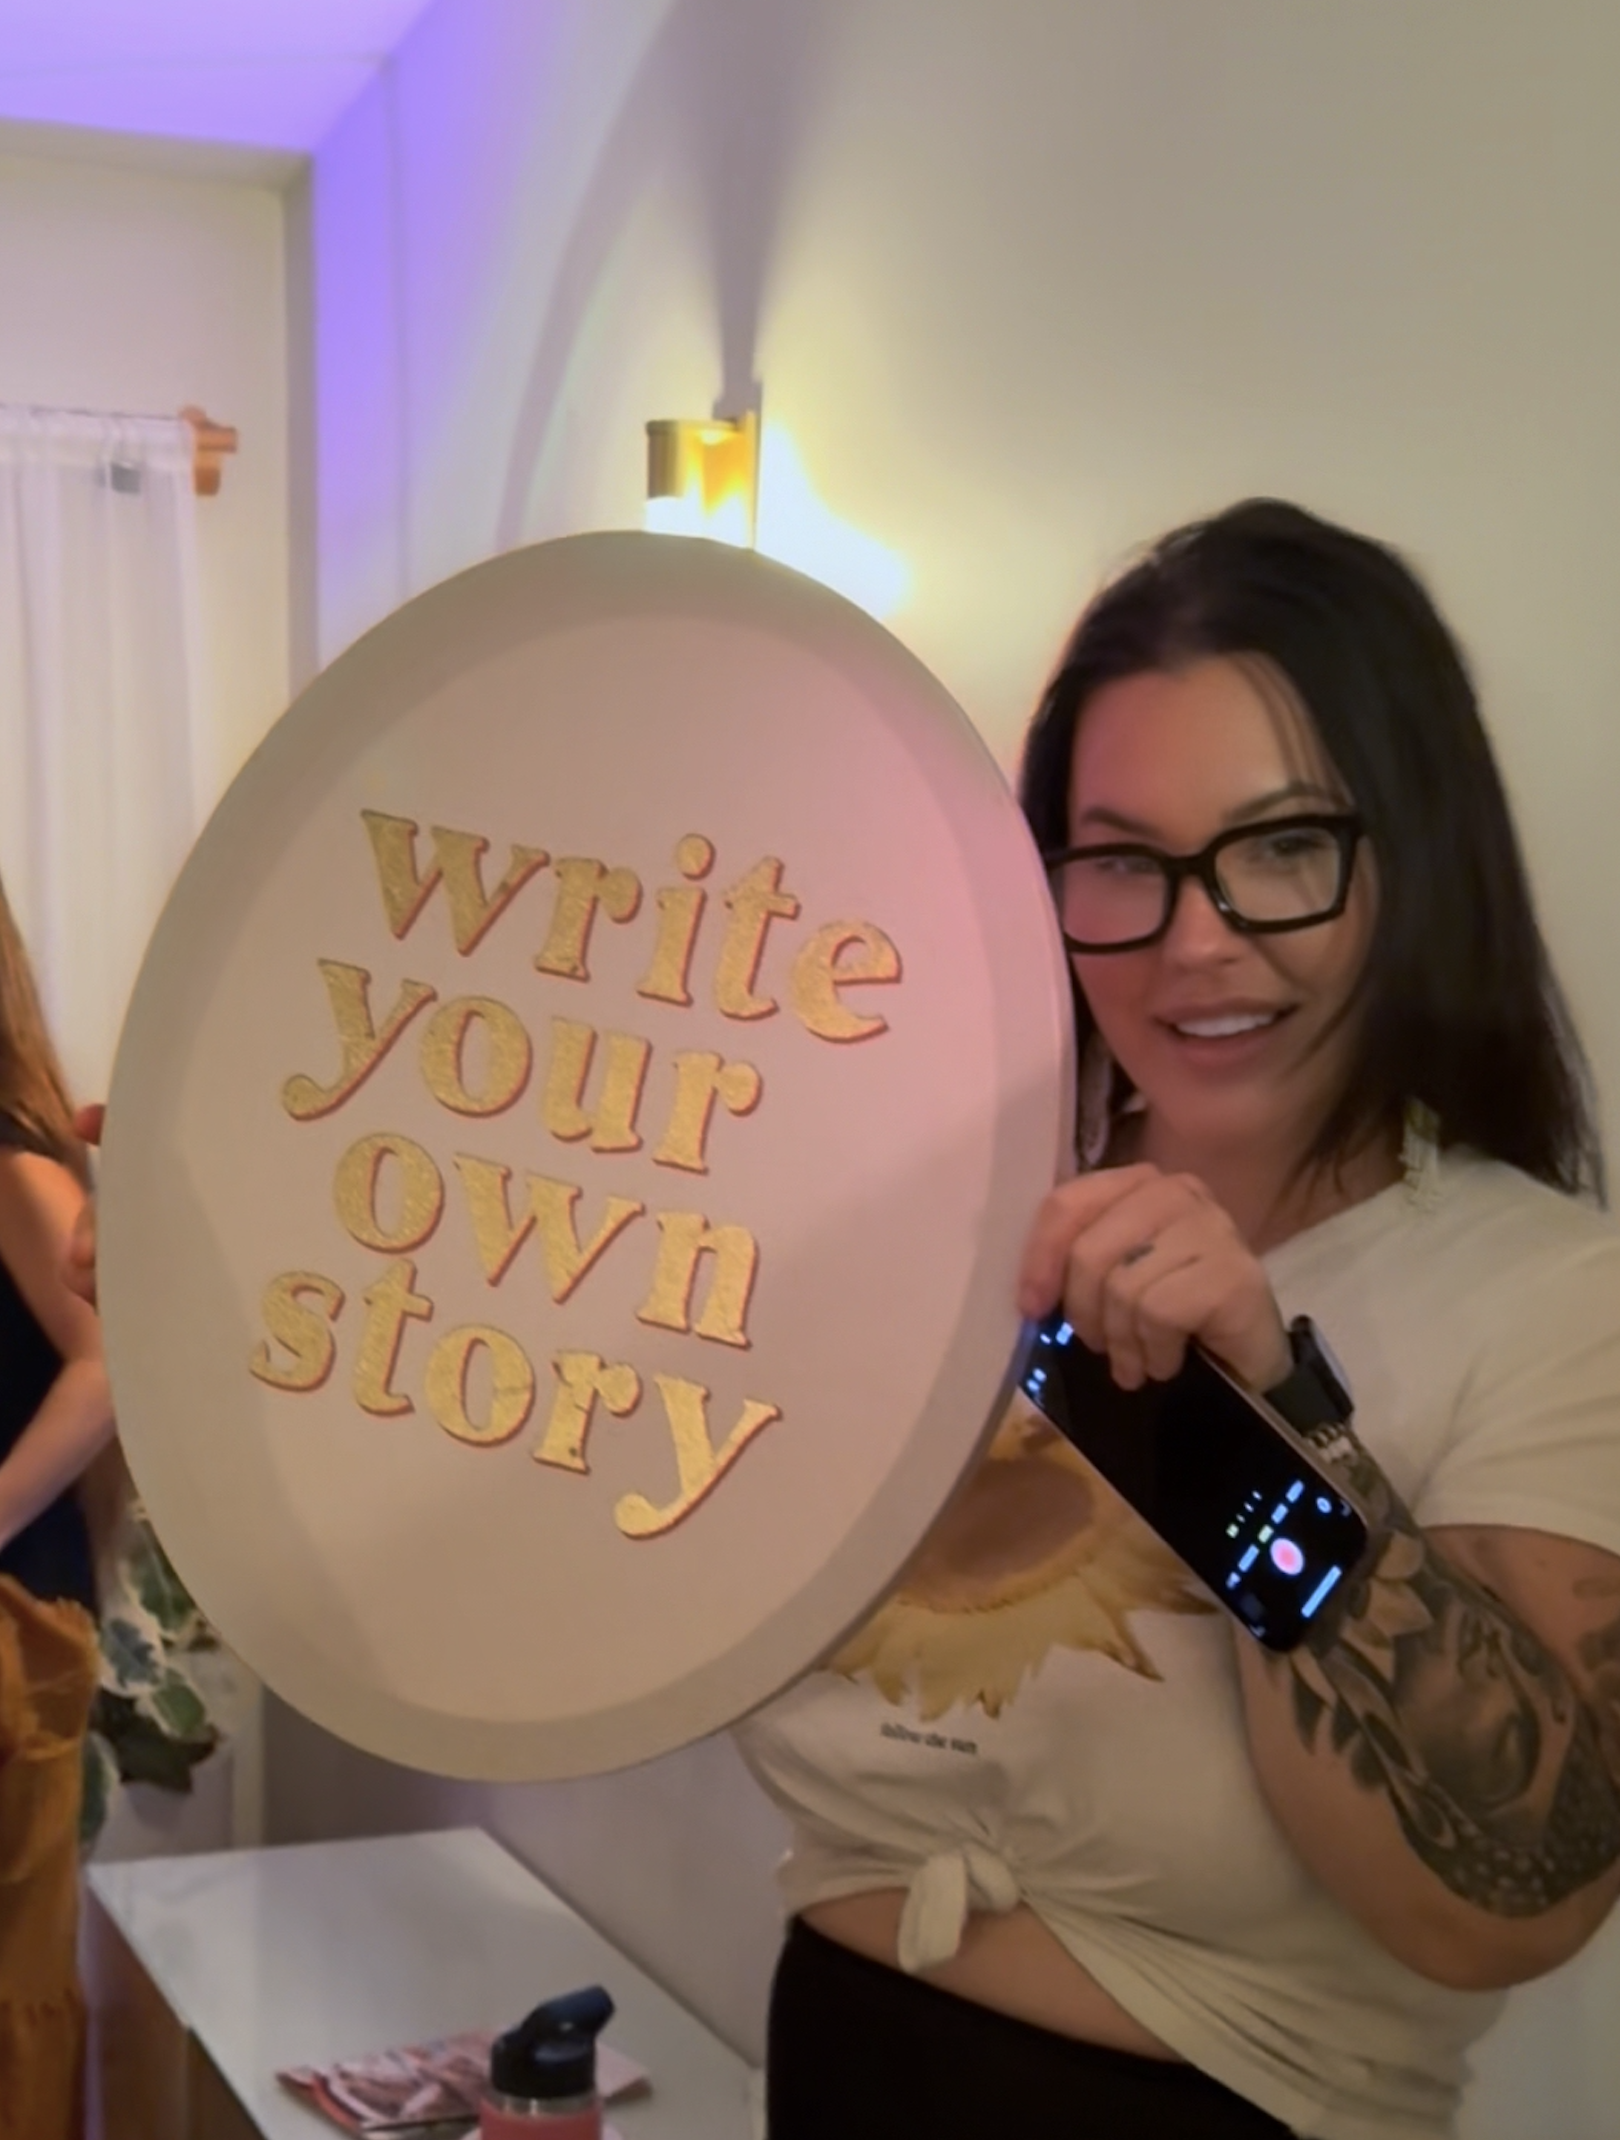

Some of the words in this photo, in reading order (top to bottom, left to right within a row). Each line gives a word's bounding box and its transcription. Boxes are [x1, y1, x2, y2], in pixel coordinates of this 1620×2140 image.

[361, 809, 902, 1043] write
[281, 958, 763, 1174] your
[334, 1132, 758, 1350] own
[250, 1259, 782, 1540] story
